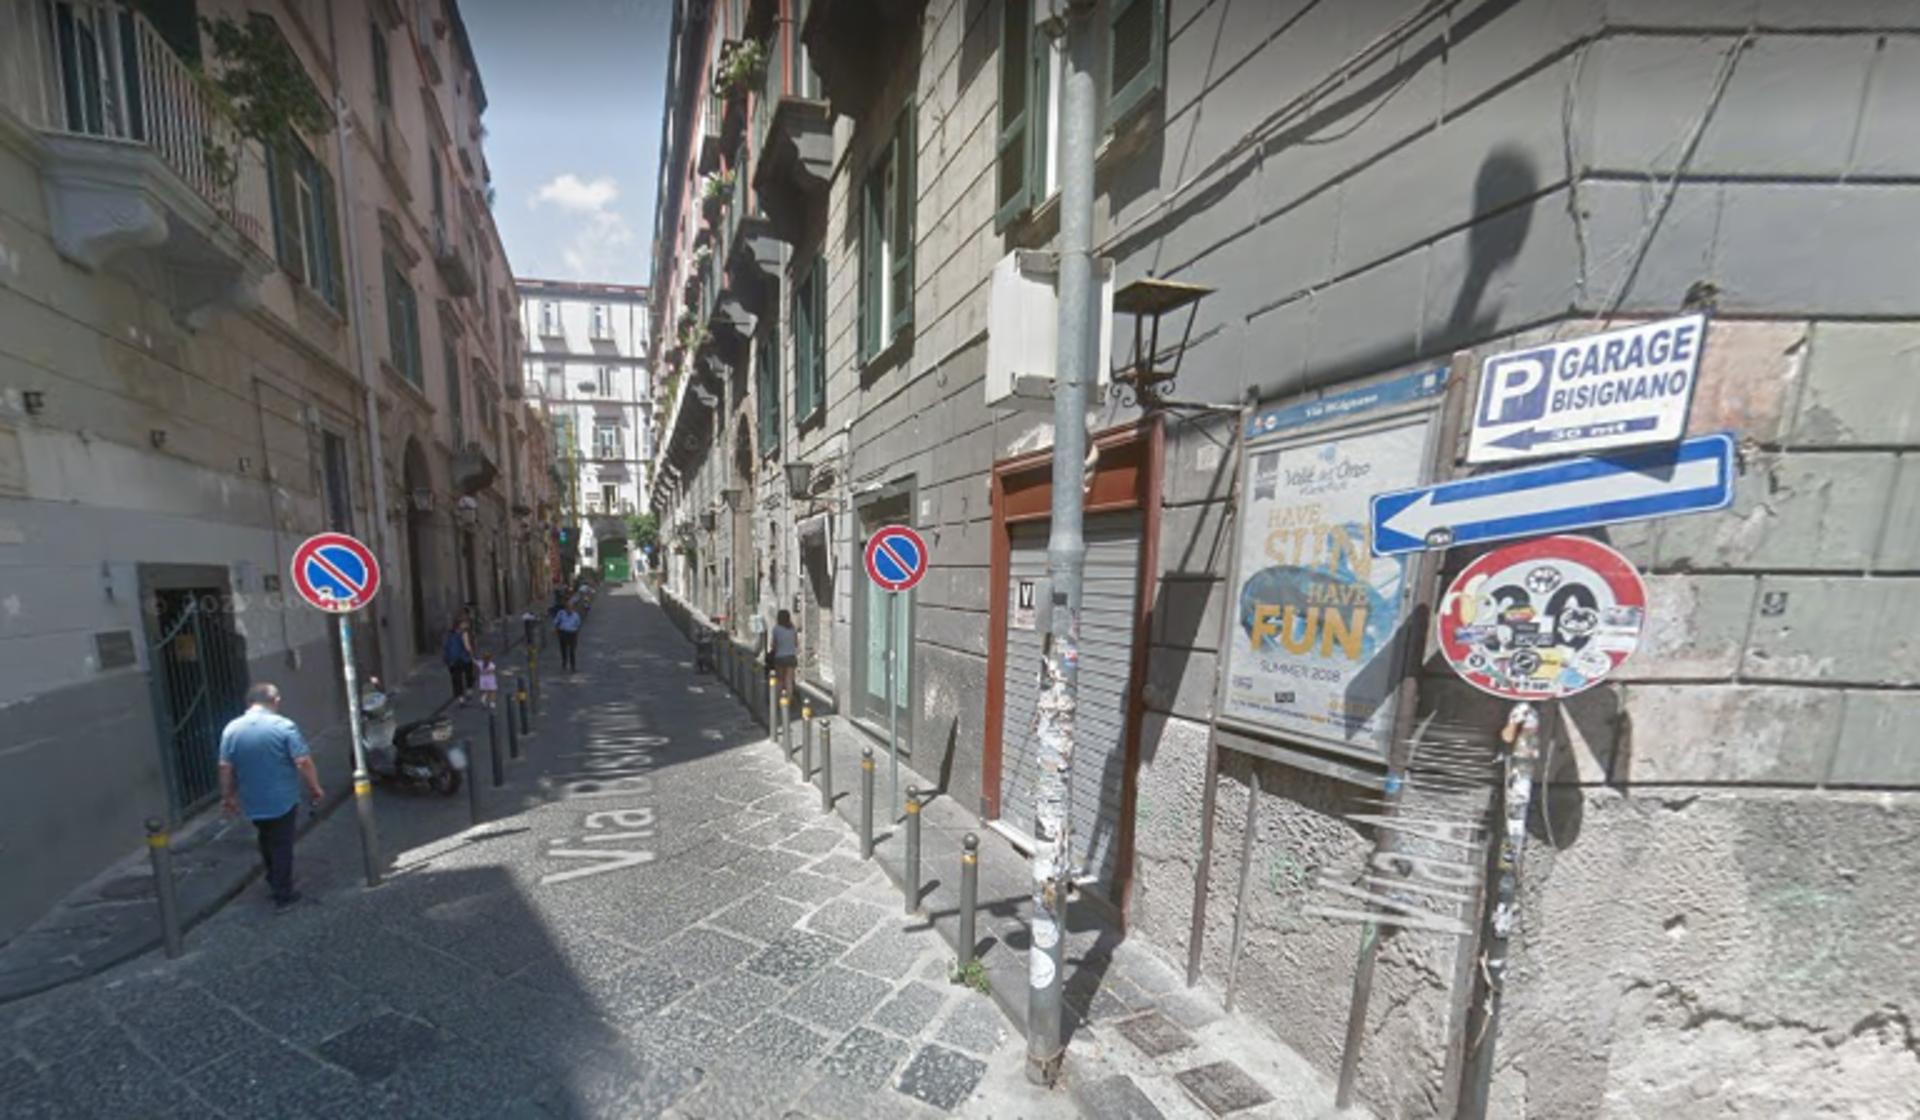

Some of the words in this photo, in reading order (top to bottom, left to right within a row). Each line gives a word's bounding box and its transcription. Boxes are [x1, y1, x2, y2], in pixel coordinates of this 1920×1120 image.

[1558, 325, 1695, 381] GARAGE
[1486, 358, 1544, 422] P
[1551, 369, 1688, 413] BISIGNANO
[1268, 503, 1321, 529] HAVE
[1264, 523, 1372, 577] SUN
[1306, 583, 1367, 605] HAVE
[1251, 603, 1369, 660] FUN
